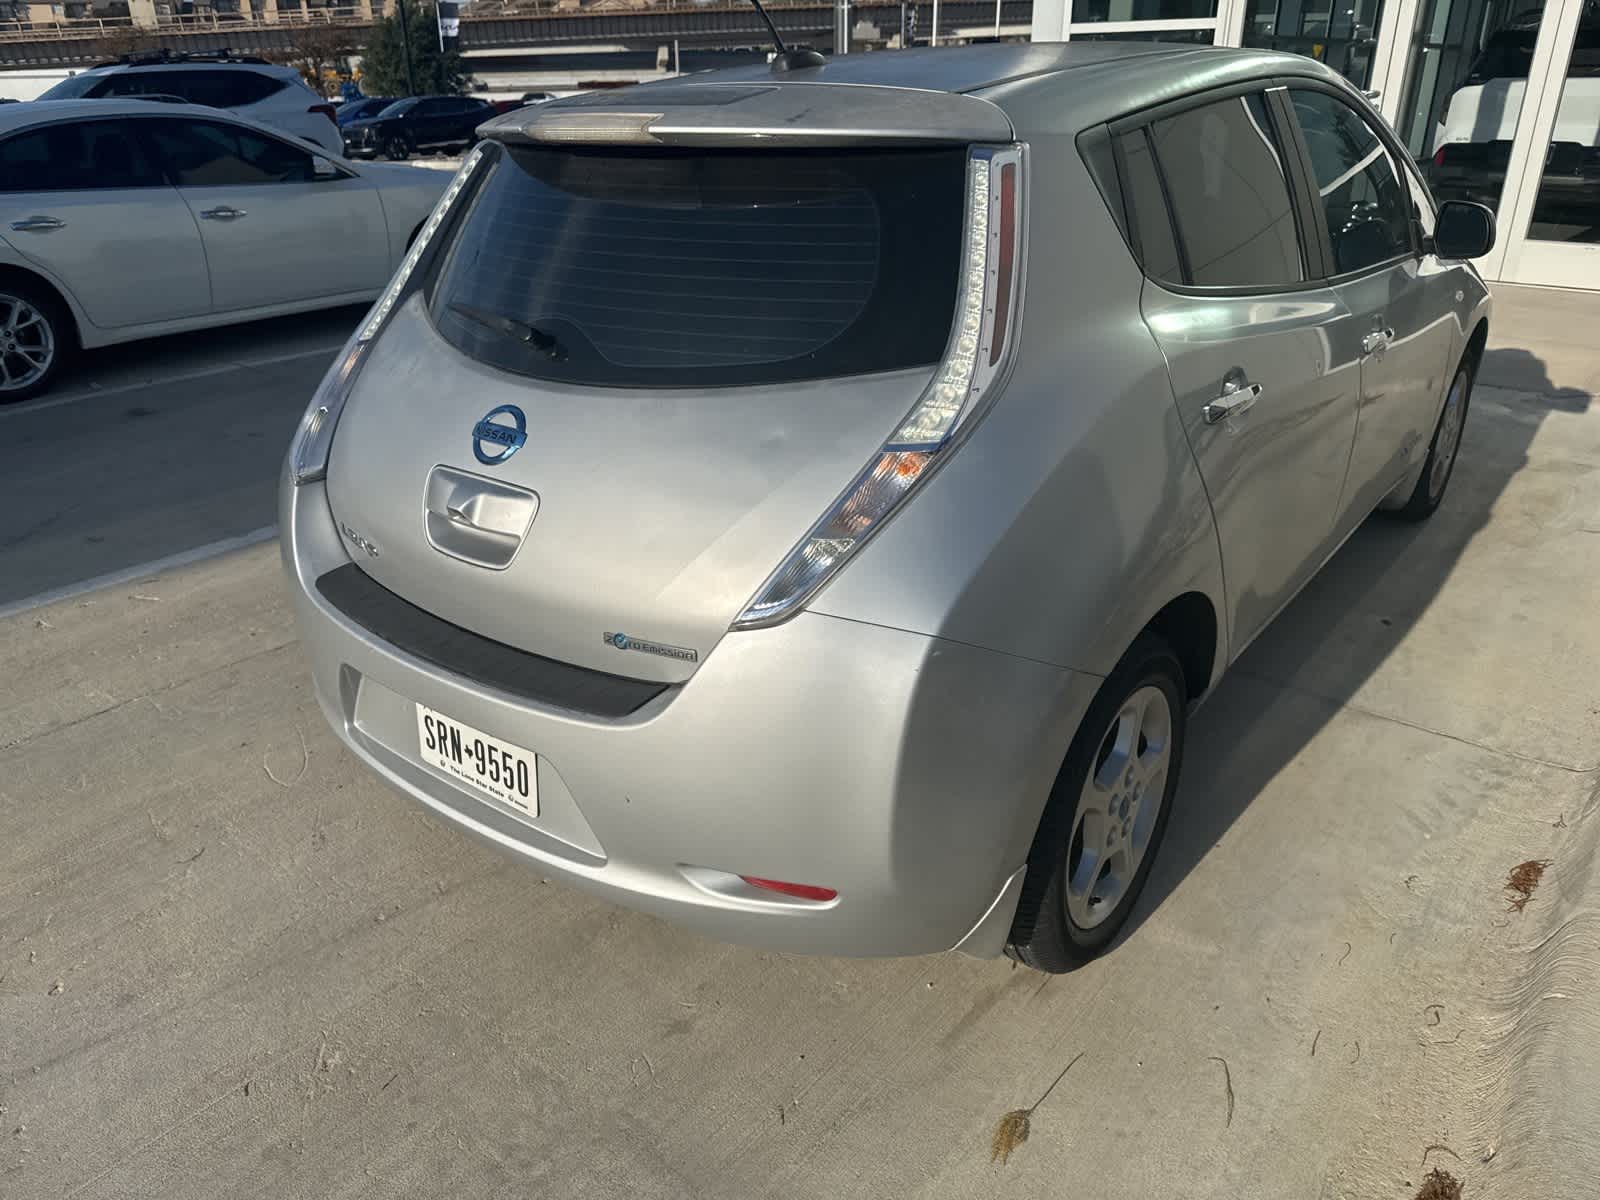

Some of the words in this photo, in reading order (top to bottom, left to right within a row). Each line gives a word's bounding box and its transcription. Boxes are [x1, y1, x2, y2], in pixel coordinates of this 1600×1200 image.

[424, 714, 463, 765] SRN
[474, 738, 530, 798] 9550
[450, 765, 460, 774] The
[461, 771, 475, 782] Lone
[476, 779, 488, 788] Star
[489, 786, 505, 797] State
